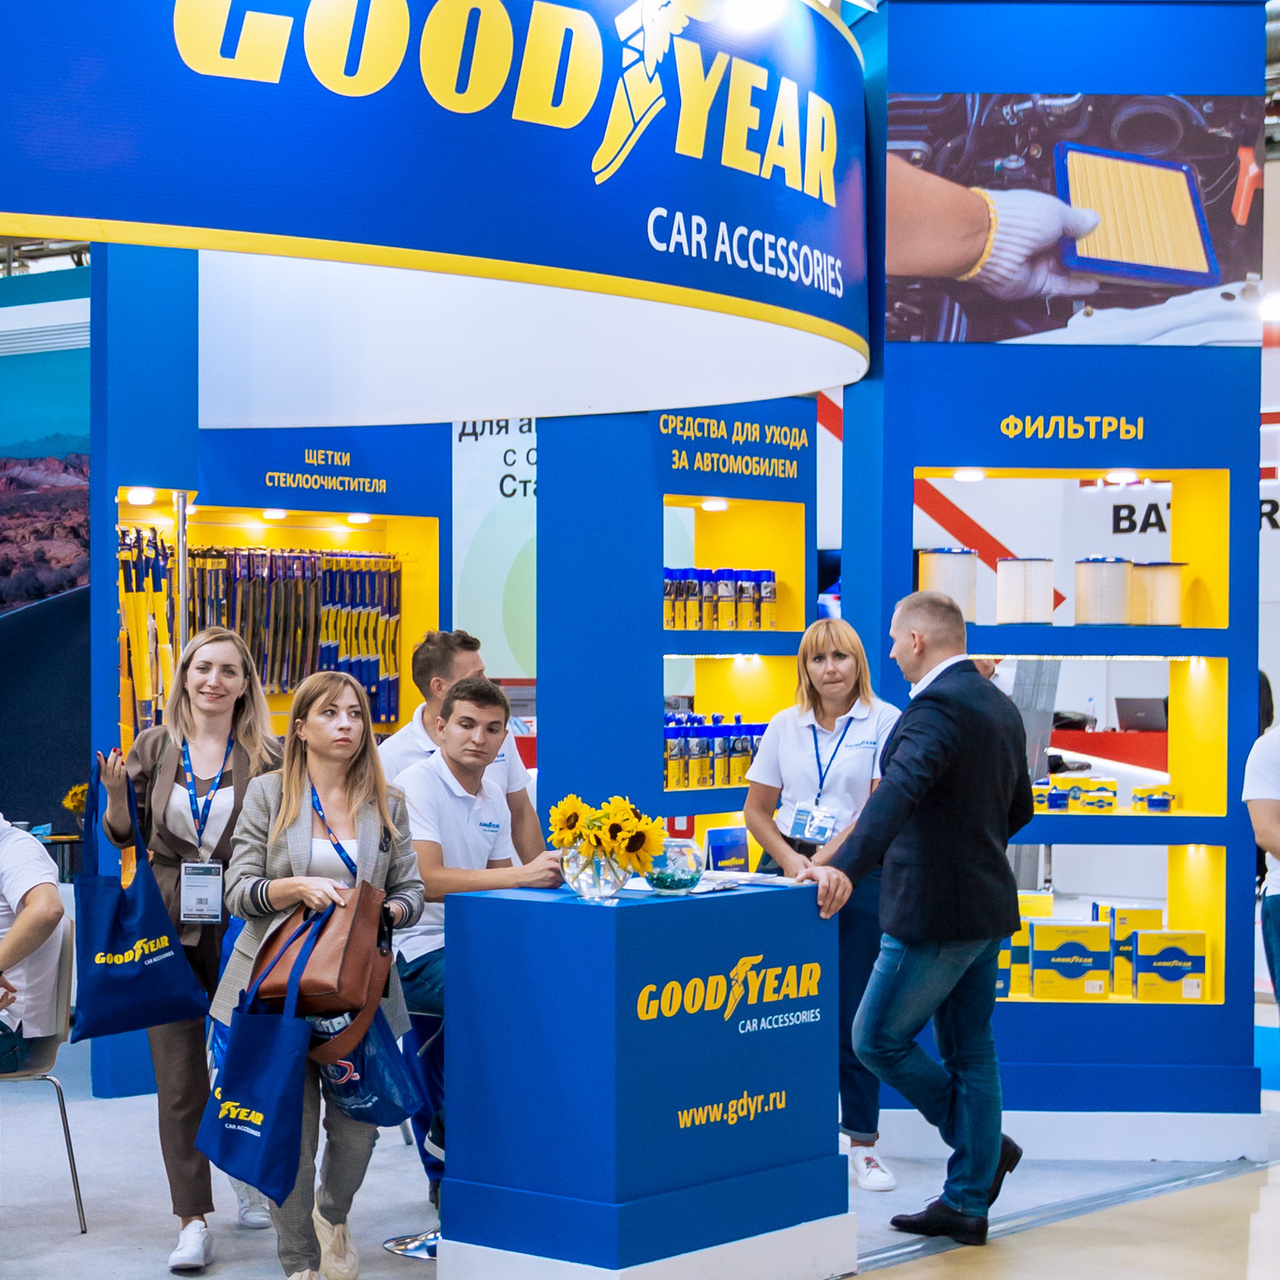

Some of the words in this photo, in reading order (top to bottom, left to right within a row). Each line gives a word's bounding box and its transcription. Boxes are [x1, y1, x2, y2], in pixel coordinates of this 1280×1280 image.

[647, 207, 708, 260] CAR
[714, 221, 844, 299] ACCESSORIES
[458, 418, 509, 442] Для
[660, 413, 727, 441] СРЕДСТВА
[731, 421, 760, 444] ДЛЯ
[764, 424, 809, 450] УХОДА
[999, 415, 1145, 441] ФИЛЬТРЫ
[304, 448, 351, 467] ЩЕТКИ
[671, 449, 690, 470] ЗА
[693, 451, 798, 479] АВТОМОБИЛЕМ
[265, 471, 387, 494] СТЕКЛООЧИСТИТЕЛЯ
[1112, 502, 1171, 535] BA
[95, 935, 170, 965] GOODYEAR
[636, 954, 822, 1021] GOODYEAR
[738, 1018, 759, 1034] CAR
[759, 1008, 821, 1030] ACCESSORIES
[677, 1090, 787, 1129] www.gdyr.ru
